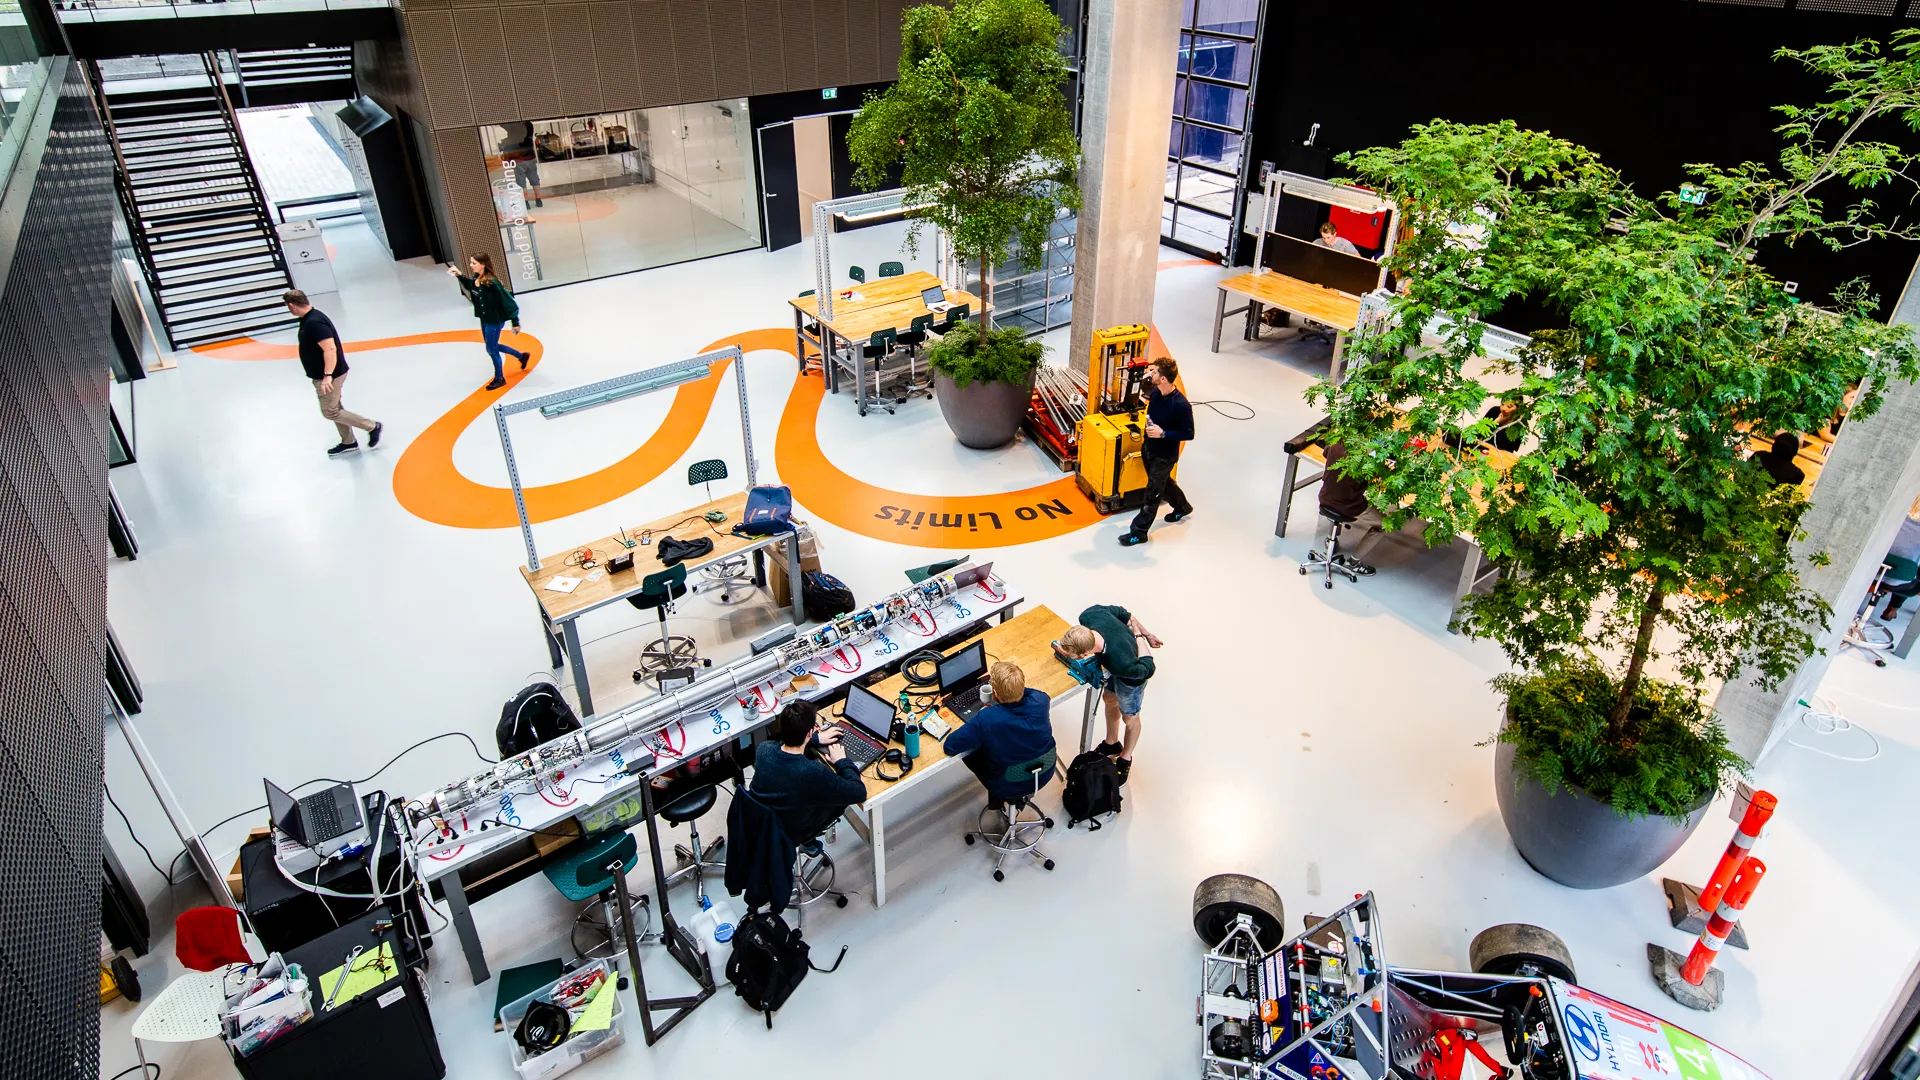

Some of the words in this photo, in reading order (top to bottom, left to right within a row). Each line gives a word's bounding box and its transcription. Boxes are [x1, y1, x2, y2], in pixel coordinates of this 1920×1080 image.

[502, 158, 528, 240] Prototyping
[518, 243, 535, 281] Rapid
[874, 505, 1003, 532] Limits
[1014, 498, 1074, 521] No
[1592, 1010, 1621, 1072] HYUNDAI
